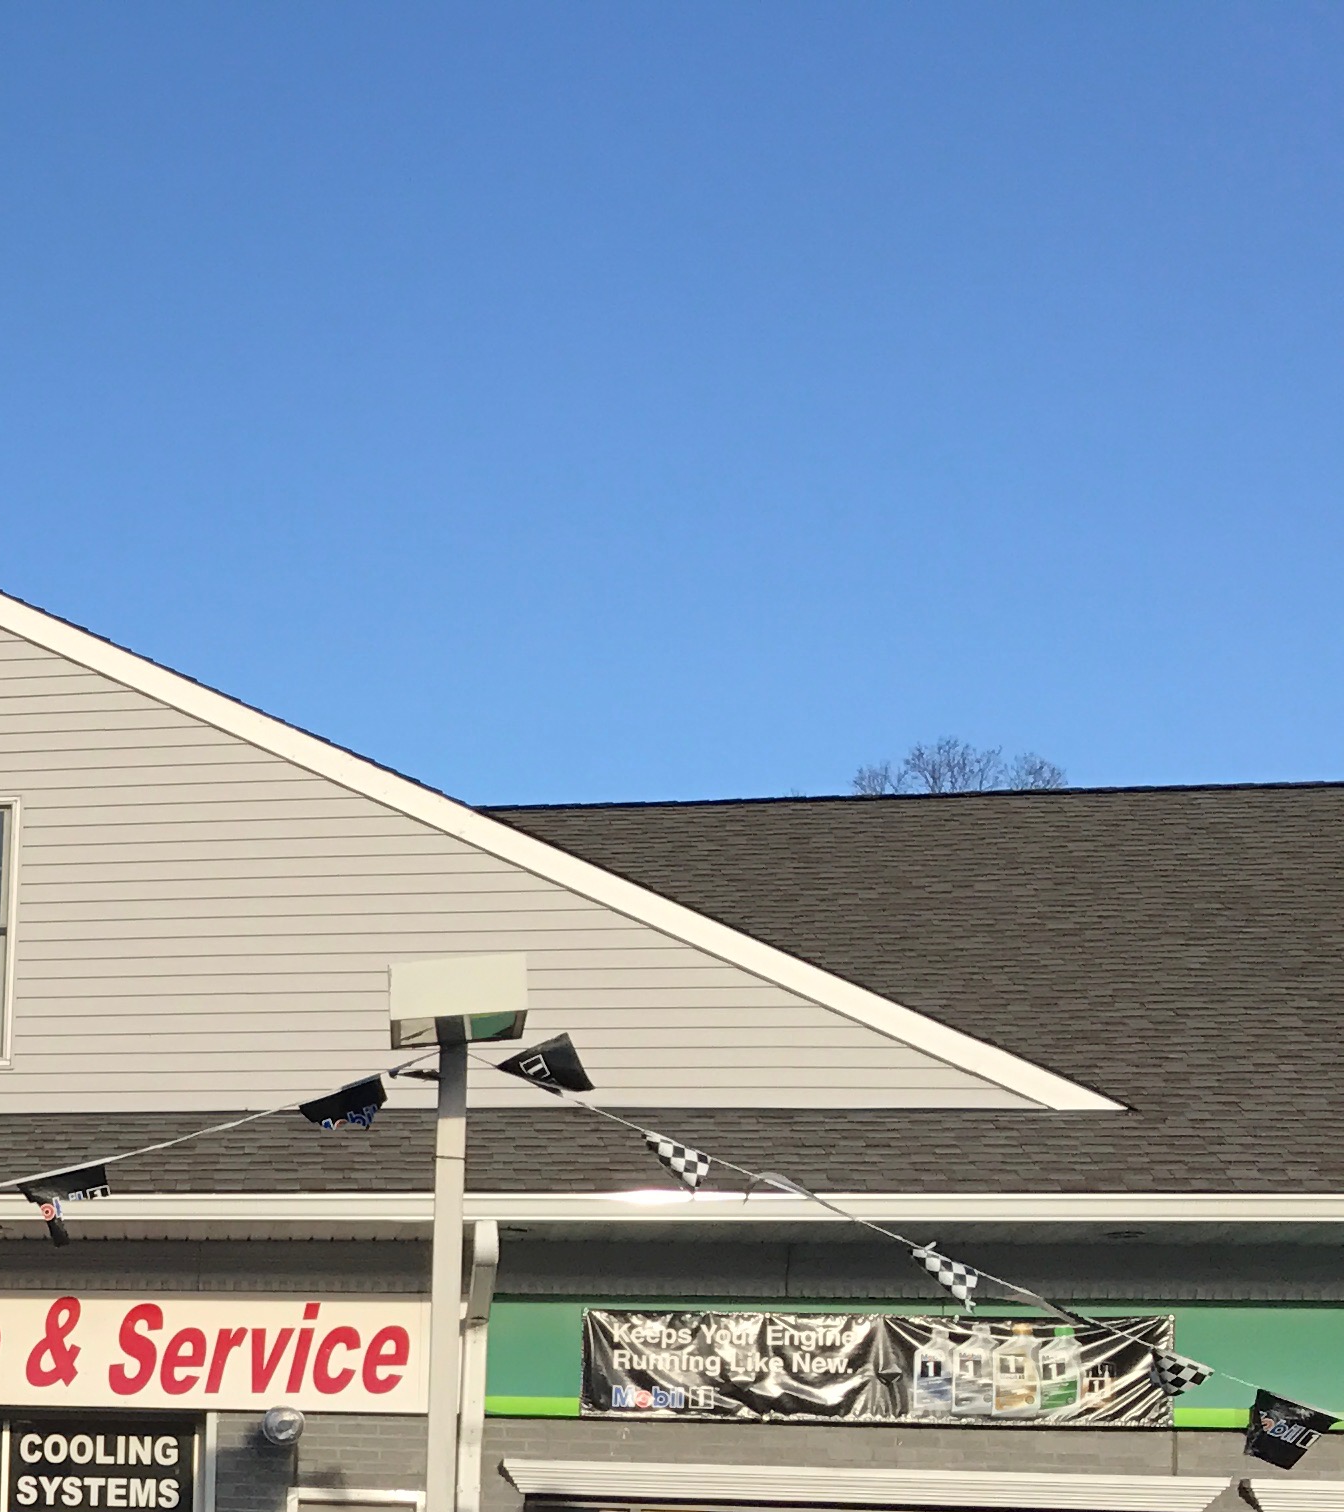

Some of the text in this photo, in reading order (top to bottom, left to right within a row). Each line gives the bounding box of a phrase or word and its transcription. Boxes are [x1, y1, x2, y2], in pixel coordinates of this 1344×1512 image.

[26, 1296, 81, 1387] &
[109, 1303, 410, 1394] Service
[613, 1323, 856, 1349] Keeps Your Engine
[613, 1350, 854, 1375] Running Like New.
[612, 1385, 685, 1409] Mobil
[19, 1433, 179, 1466] COOLING
[16, 1475, 180, 1508] SYSTEMS
